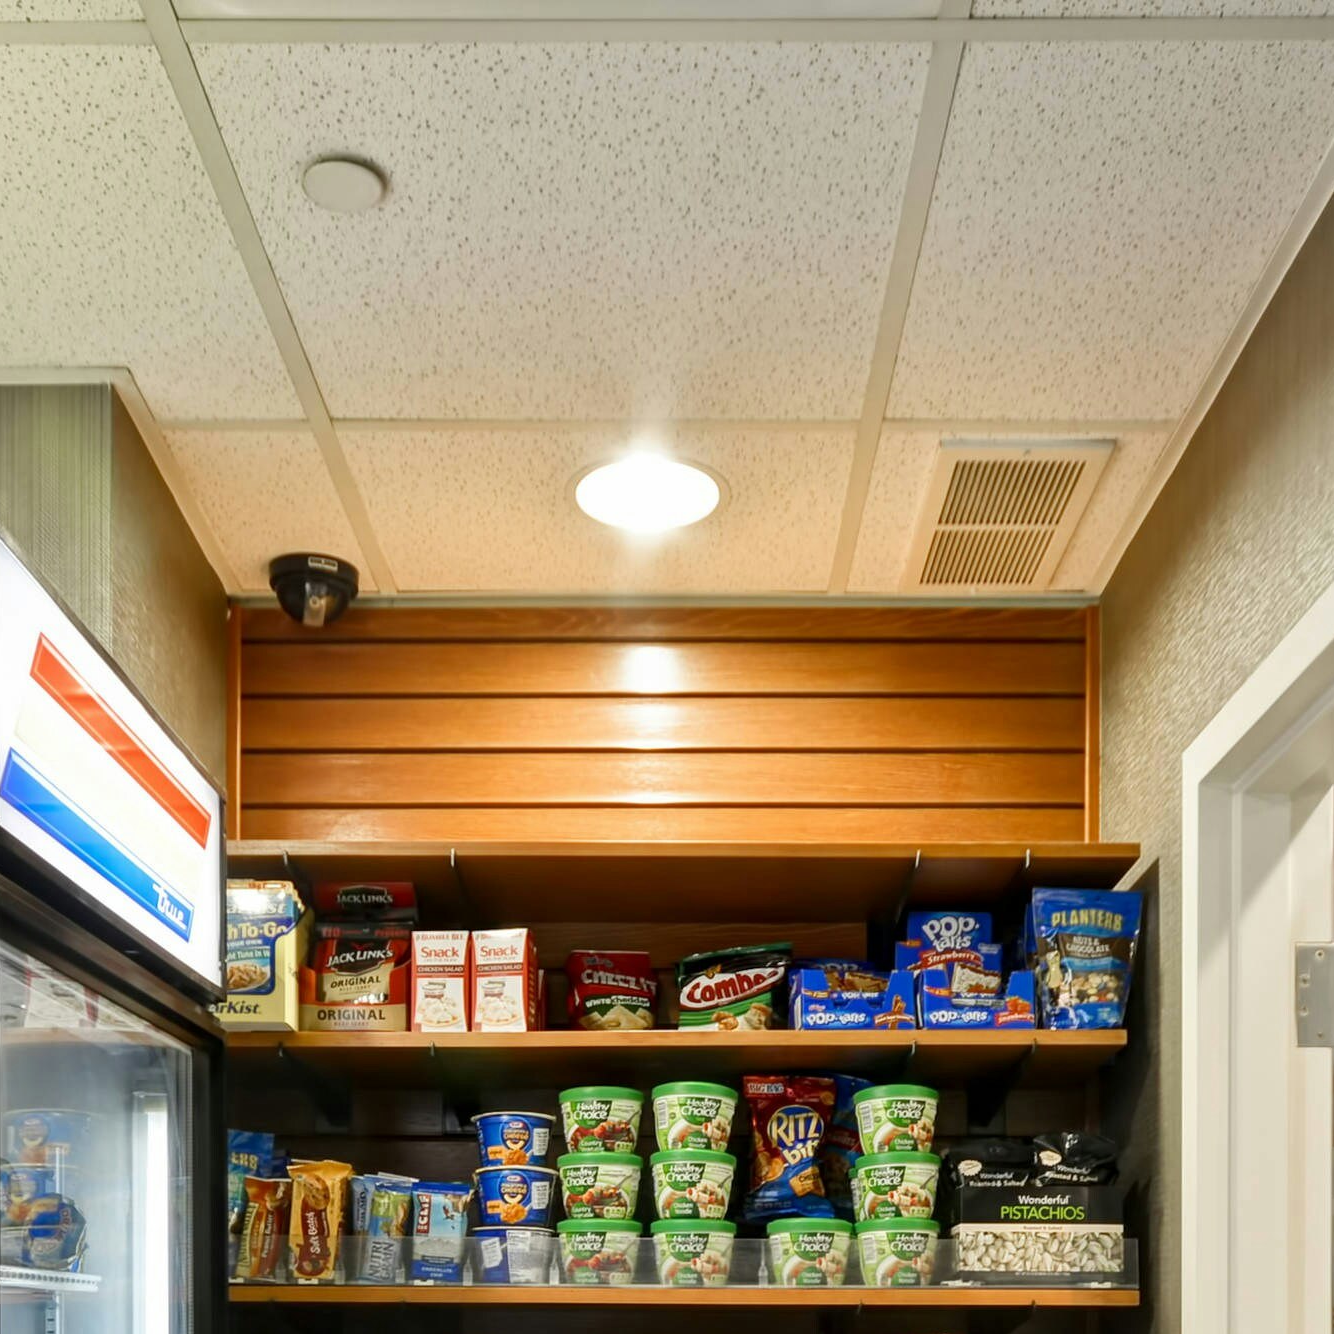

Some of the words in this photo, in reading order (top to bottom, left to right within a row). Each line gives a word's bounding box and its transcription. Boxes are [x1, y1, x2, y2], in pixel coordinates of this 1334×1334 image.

[153, 882, 186, 930] true
[1050, 909, 1123, 932] PLANTERS
[420, 945, 460, 958] Snack
[479, 943, 520, 957] Snack
[1065, 943, 1110, 954] CHOCOLATE
[326, 953, 356, 968] JACK
[926, 952, 975, 964] Strawberry
[477, 964, 502, 972] CHICKEN
[503, 963, 522, 971] SALAD
[330, 975, 382, 989] ORIGINAL
[316, 1007, 387, 1021] ORIGINAL
[577, 1101, 611, 1113] Healthy
[687, 1098, 720, 1110] Healthy
[891, 1100, 924, 1111] Healthy
[573, 1109, 608, 1121] Choice
[680, 1106, 717, 1118] Choice
[886, 1107, 922, 1119] Choice
[770, 1113, 821, 1145] RITZ
[566, 1167, 598, 1178] Healthy
[669, 1164, 707, 1176] Healthy
[870, 1167, 904, 1179] Healthy
[566, 1174, 594, 1187] Choice
[665, 1172, 701, 1183] Choice
[867, 1174, 902, 1187] Choice
[1017, 1194, 1070, 1205] Wonderful
[1000, 1206, 1085, 1221] PISTACHIOS
[570, 1240, 603, 1252] Choice
[669, 1242, 705, 1253] Choice
